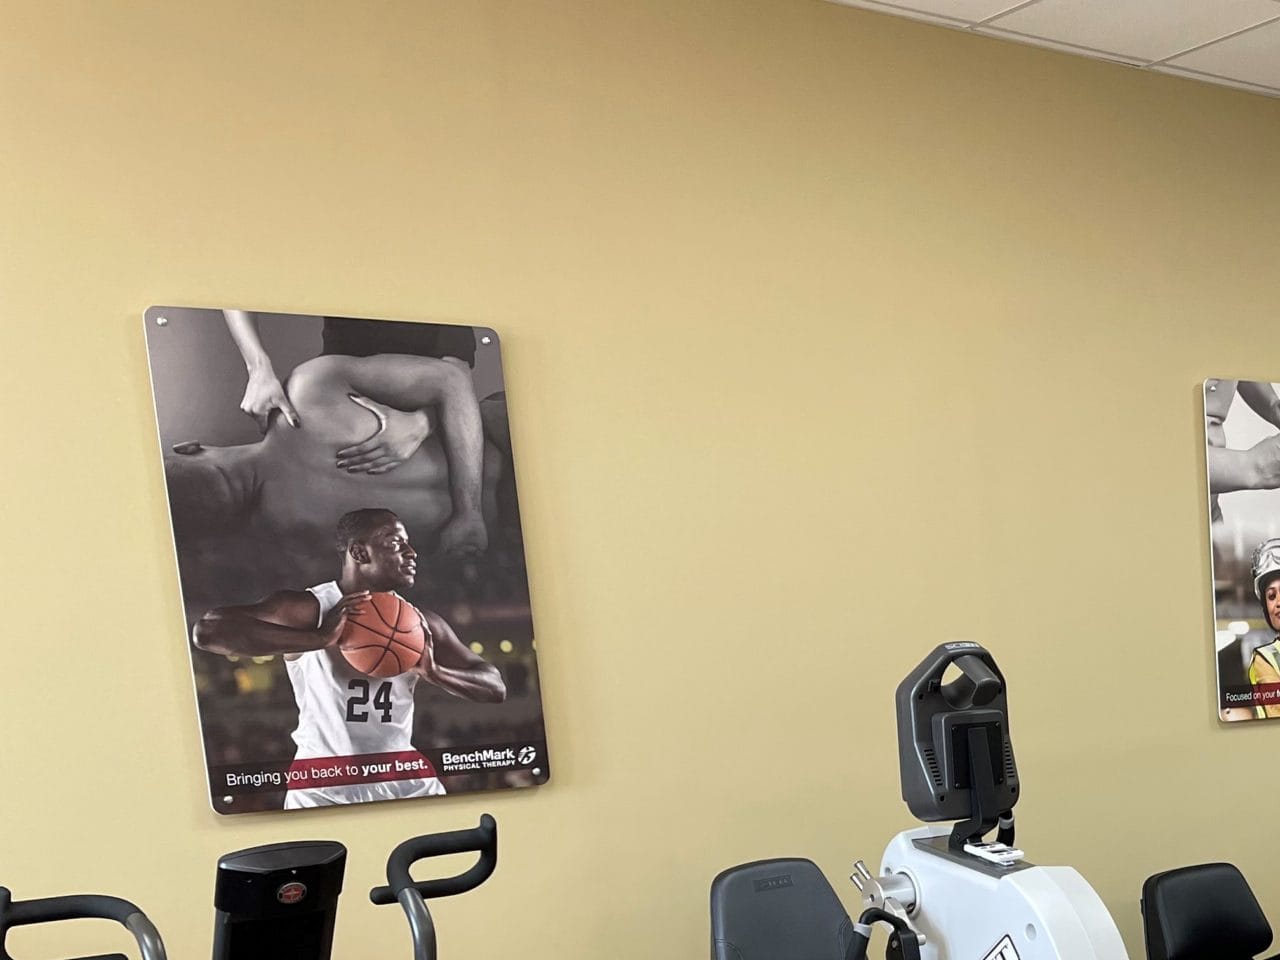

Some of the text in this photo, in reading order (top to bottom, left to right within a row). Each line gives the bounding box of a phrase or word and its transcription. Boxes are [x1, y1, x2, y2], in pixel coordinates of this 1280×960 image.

[346, 679, 393, 722] 24
[1225, 692, 1252, 701] Focused
[1262, 692, 1276, 700] your
[442, 748, 515, 764] BenchMark
[226, 758, 428, 786] Bringing you back to your best.
[444, 760, 516, 771] PHYSICAL THERAPY
